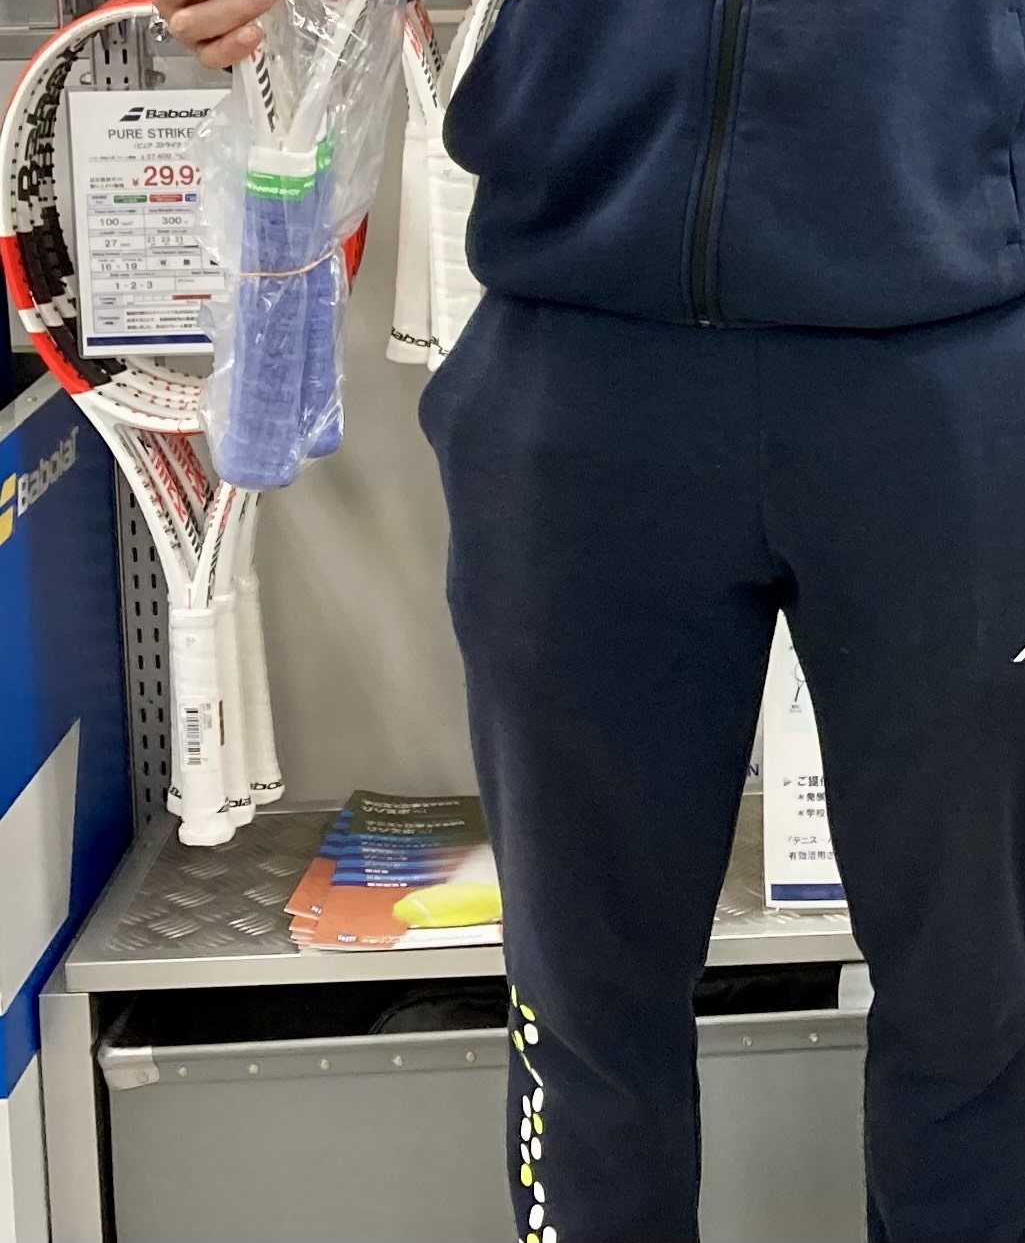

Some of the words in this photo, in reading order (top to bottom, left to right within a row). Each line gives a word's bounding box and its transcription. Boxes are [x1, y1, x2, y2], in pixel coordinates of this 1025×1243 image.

[145, 108, 211, 119] Babolat
[108, 129, 143, 139] PURE
[100, 218, 119, 226] 100
[162, 217, 182, 225] 300
[101, 263, 112, 271] 16
[17, 425, 80, 517] Babolat
